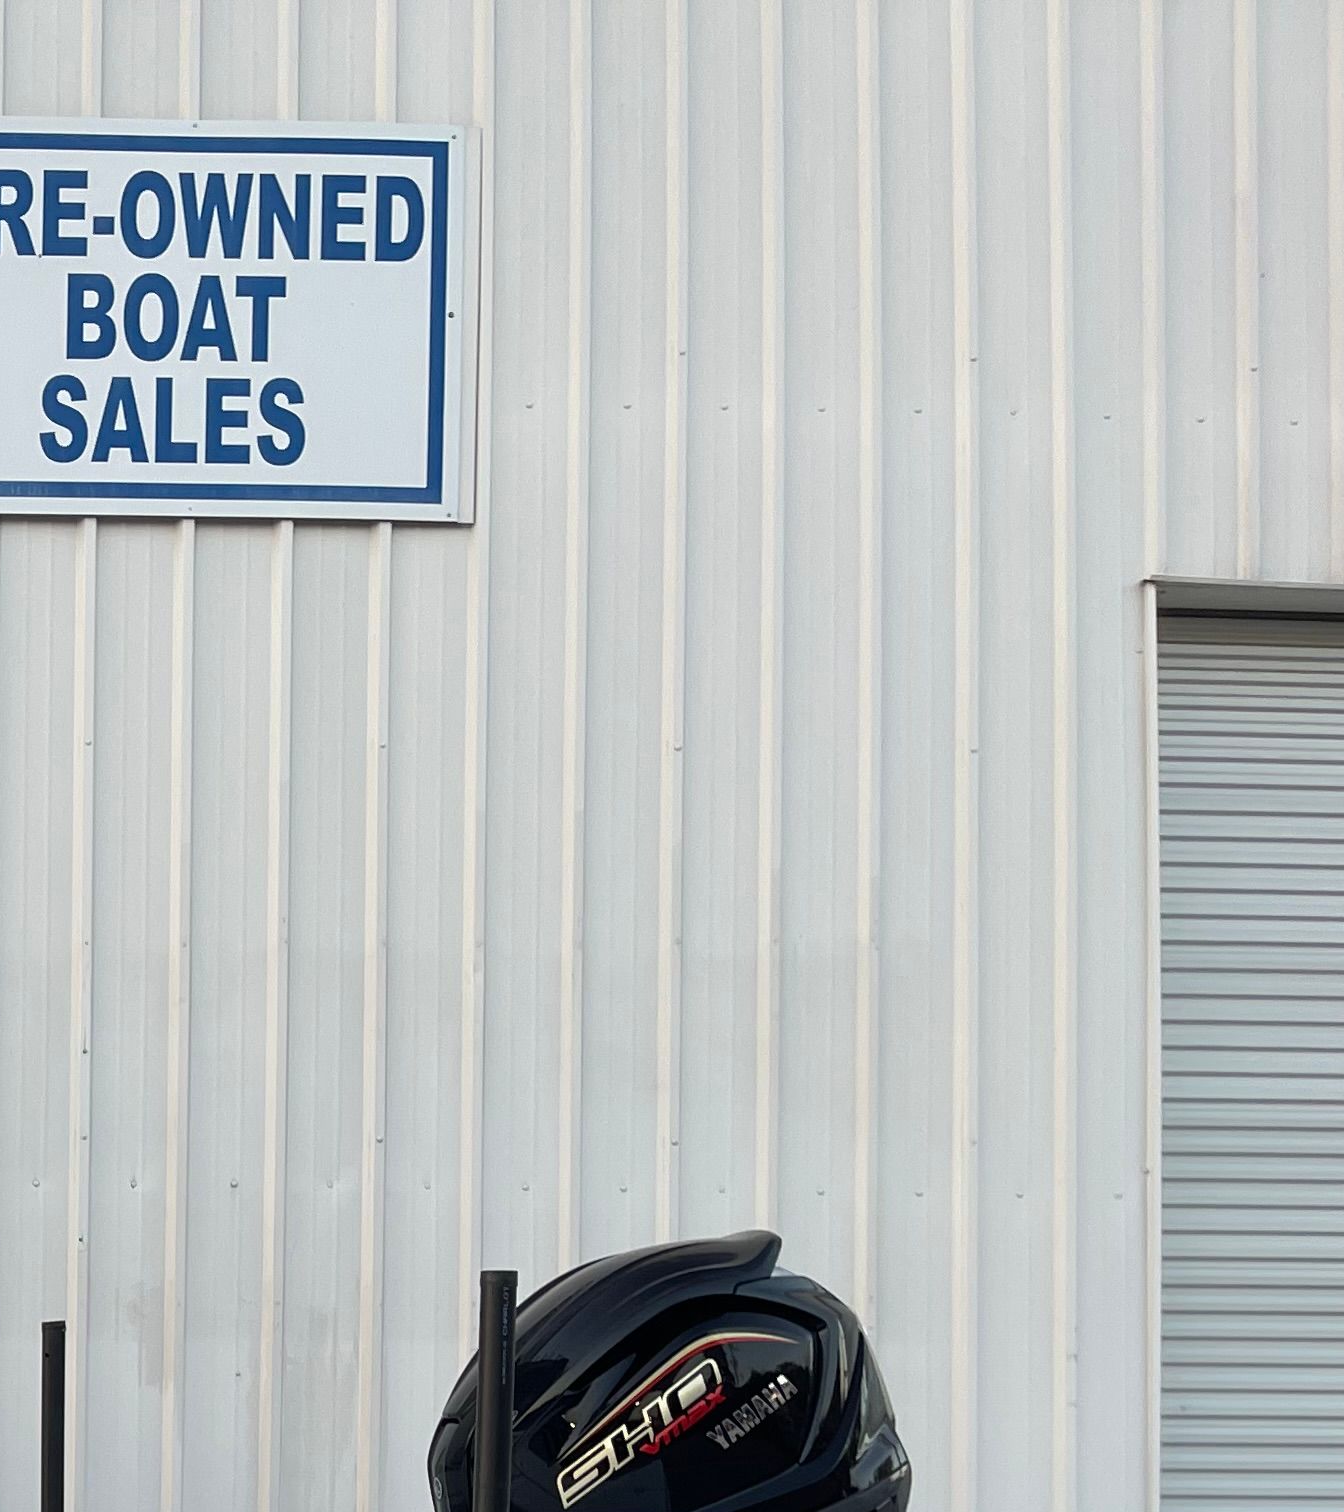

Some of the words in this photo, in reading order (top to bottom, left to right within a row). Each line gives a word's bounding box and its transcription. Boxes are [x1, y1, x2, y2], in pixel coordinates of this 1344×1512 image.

[66, 273, 287, 362] BOAT
[38, 374, 306, 466] SALES
[556, 1357, 723, 1510] SHO
[706, 1374, 799, 1450] YAMAHA
